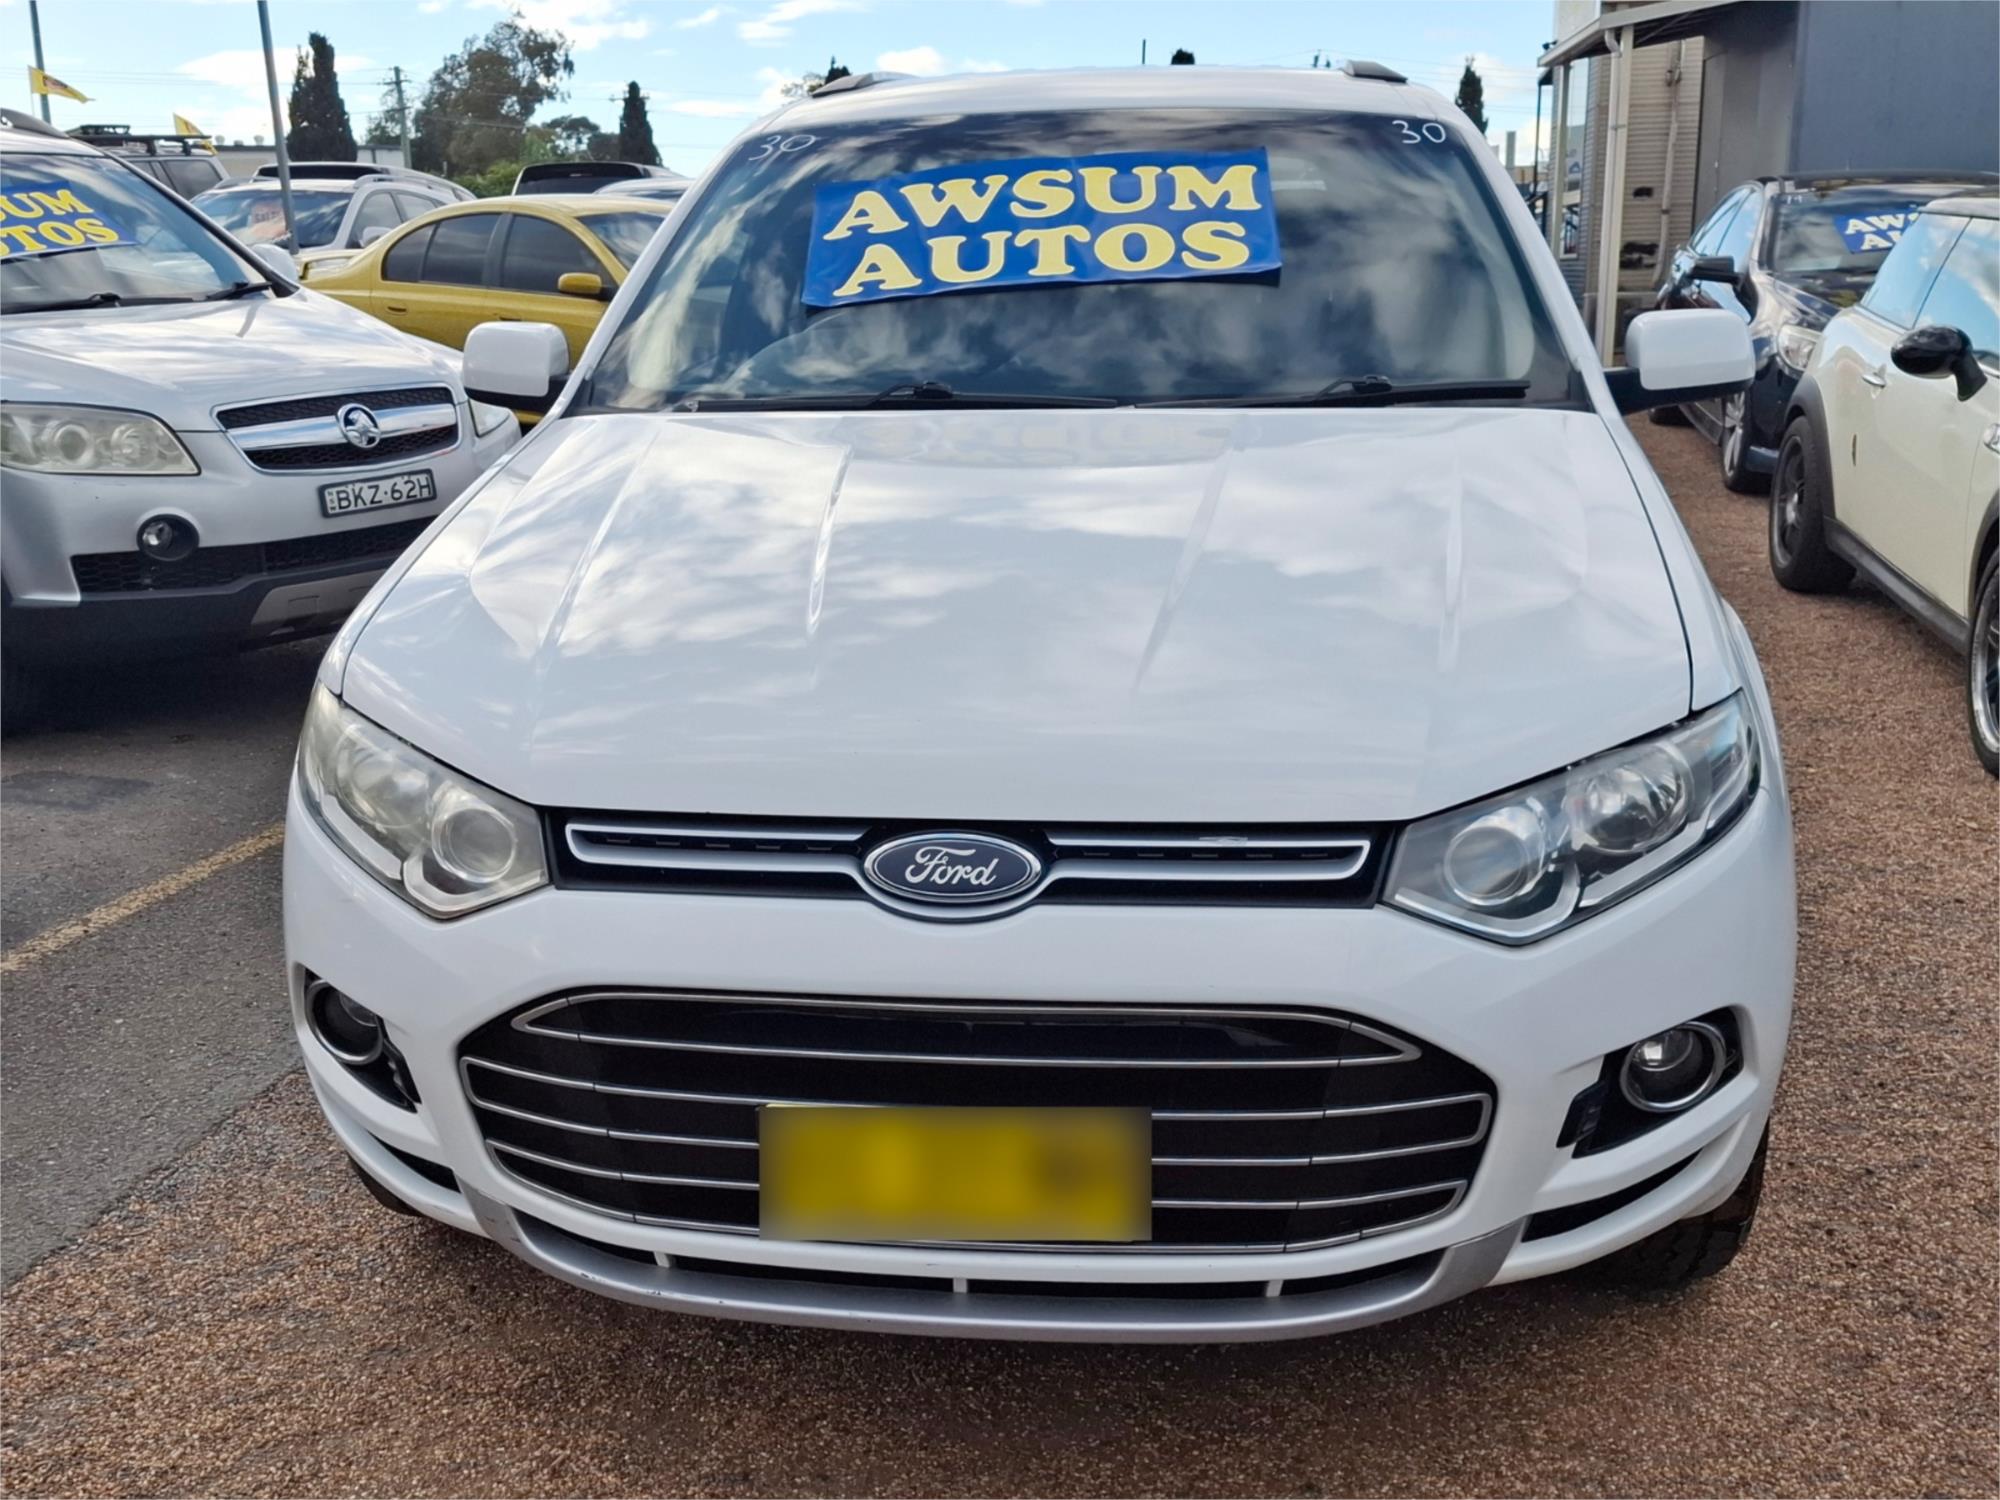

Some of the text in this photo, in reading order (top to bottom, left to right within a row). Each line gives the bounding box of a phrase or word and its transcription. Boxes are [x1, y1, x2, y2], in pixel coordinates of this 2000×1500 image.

[748, 134, 816, 161] 30
[1392, 120, 1446, 143] 30
[0, 187, 94, 222] UM
[823, 165, 1262, 240] AWSUM
[0, 218, 119, 257] TOS
[832, 221, 1249, 297] AUTOS
[905, 846, 999, 887] Ford
